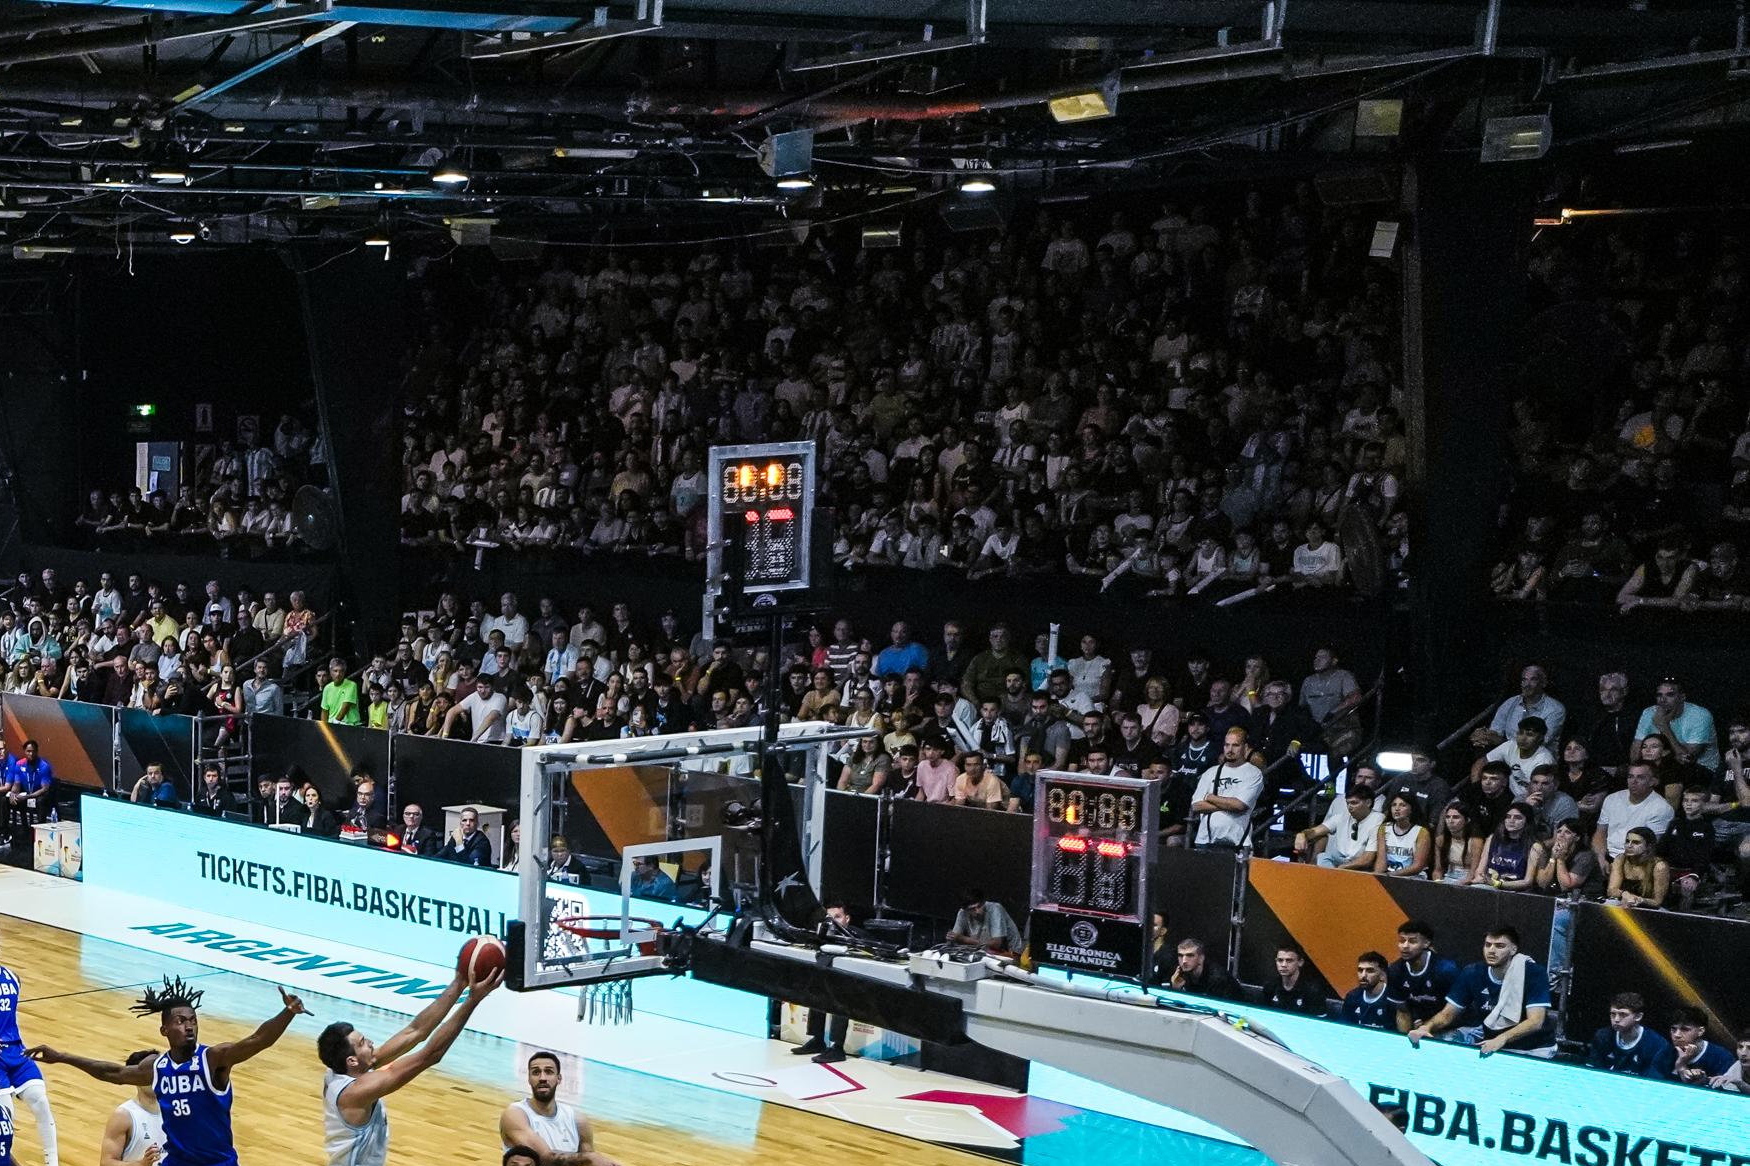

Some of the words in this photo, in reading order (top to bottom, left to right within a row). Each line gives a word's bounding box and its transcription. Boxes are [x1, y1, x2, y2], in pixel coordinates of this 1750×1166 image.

[1046, 942, 1122, 961] ELECTRONICA
[1050, 951, 1117, 968] FERNANDEZ
[0, 998, 11, 1012] 32
[160, 1074, 206, 1095] CUBA
[171, 1098, 191, 1117] 35
[0, 1141, 7, 1157] 5
